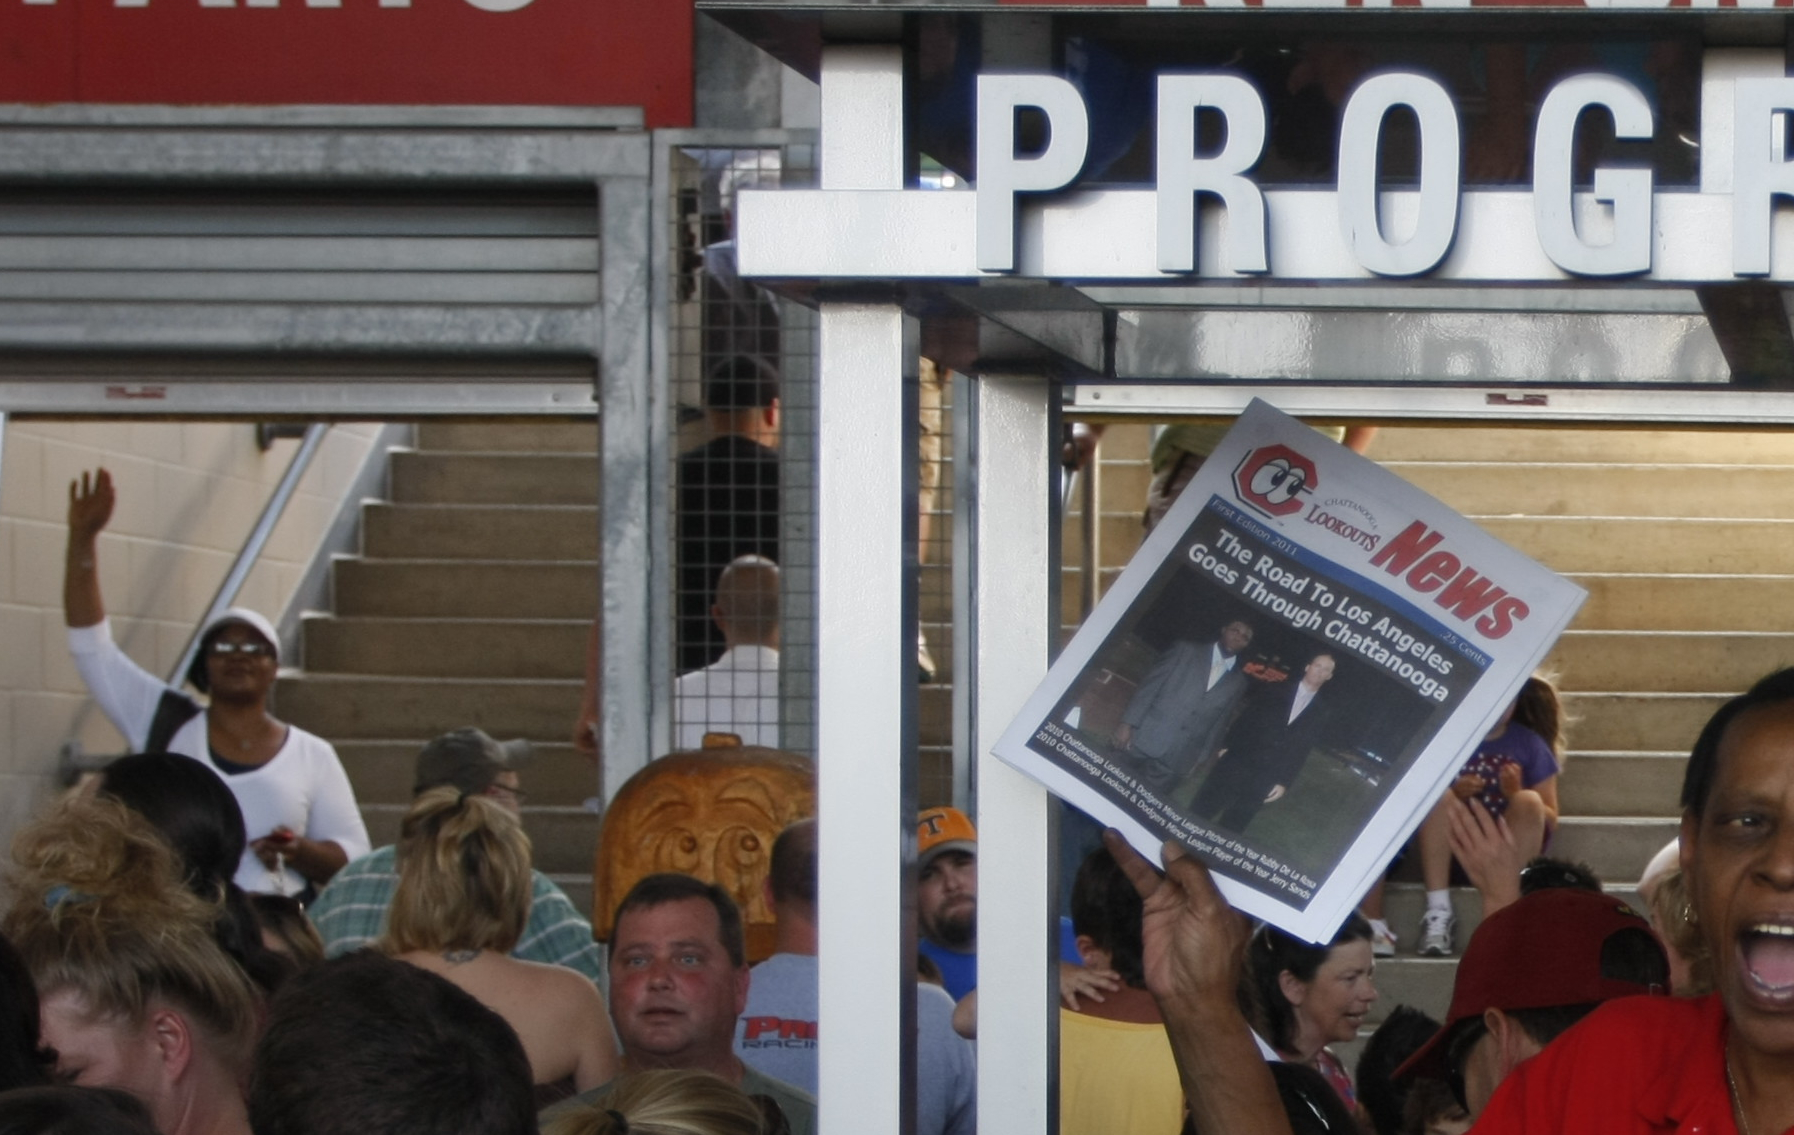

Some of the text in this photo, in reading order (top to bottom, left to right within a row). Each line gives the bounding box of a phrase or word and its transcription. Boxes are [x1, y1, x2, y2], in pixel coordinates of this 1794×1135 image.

[1212, 500, 1298, 556] First Edition 2011
[1305, 504, 1530, 640] LOOKOUTS News
[1323, 497, 1379, 532] CHATTANOOGA
[1188, 542, 1450, 702] Goes Through Chattanooga
[1215, 529, 1454, 676] The Road To Los Angeles
[1456, 640, 1489, 666] Cents
[918, 814, 945, 835] T
[1036, 730, 1310, 900] 2010 Chattanooga Lookout & Dodgers Minor League Player of the Year Jerry Sands
[1044, 722, 1063, 737] 2010
[1060, 733, 1105, 766] Chattanooga
[1102, 761, 1131, 783] Lookout
[1130, 780, 1137, 788] &
[1134, 784, 1165, 809] Dodgers
[1162, 805, 1182, 822] Minor
[1181, 818, 1205, 837] League
[1205, 829, 1226, 846] Pitcher
[1226, 839, 1235, 848] of
[1234, 842, 1245, 853] the
[1244, 848, 1259, 860] Year
[1279, 865, 1290, 875] De
[1290, 870, 1299, 879] La
[1300, 875, 1317, 888] Rosa
